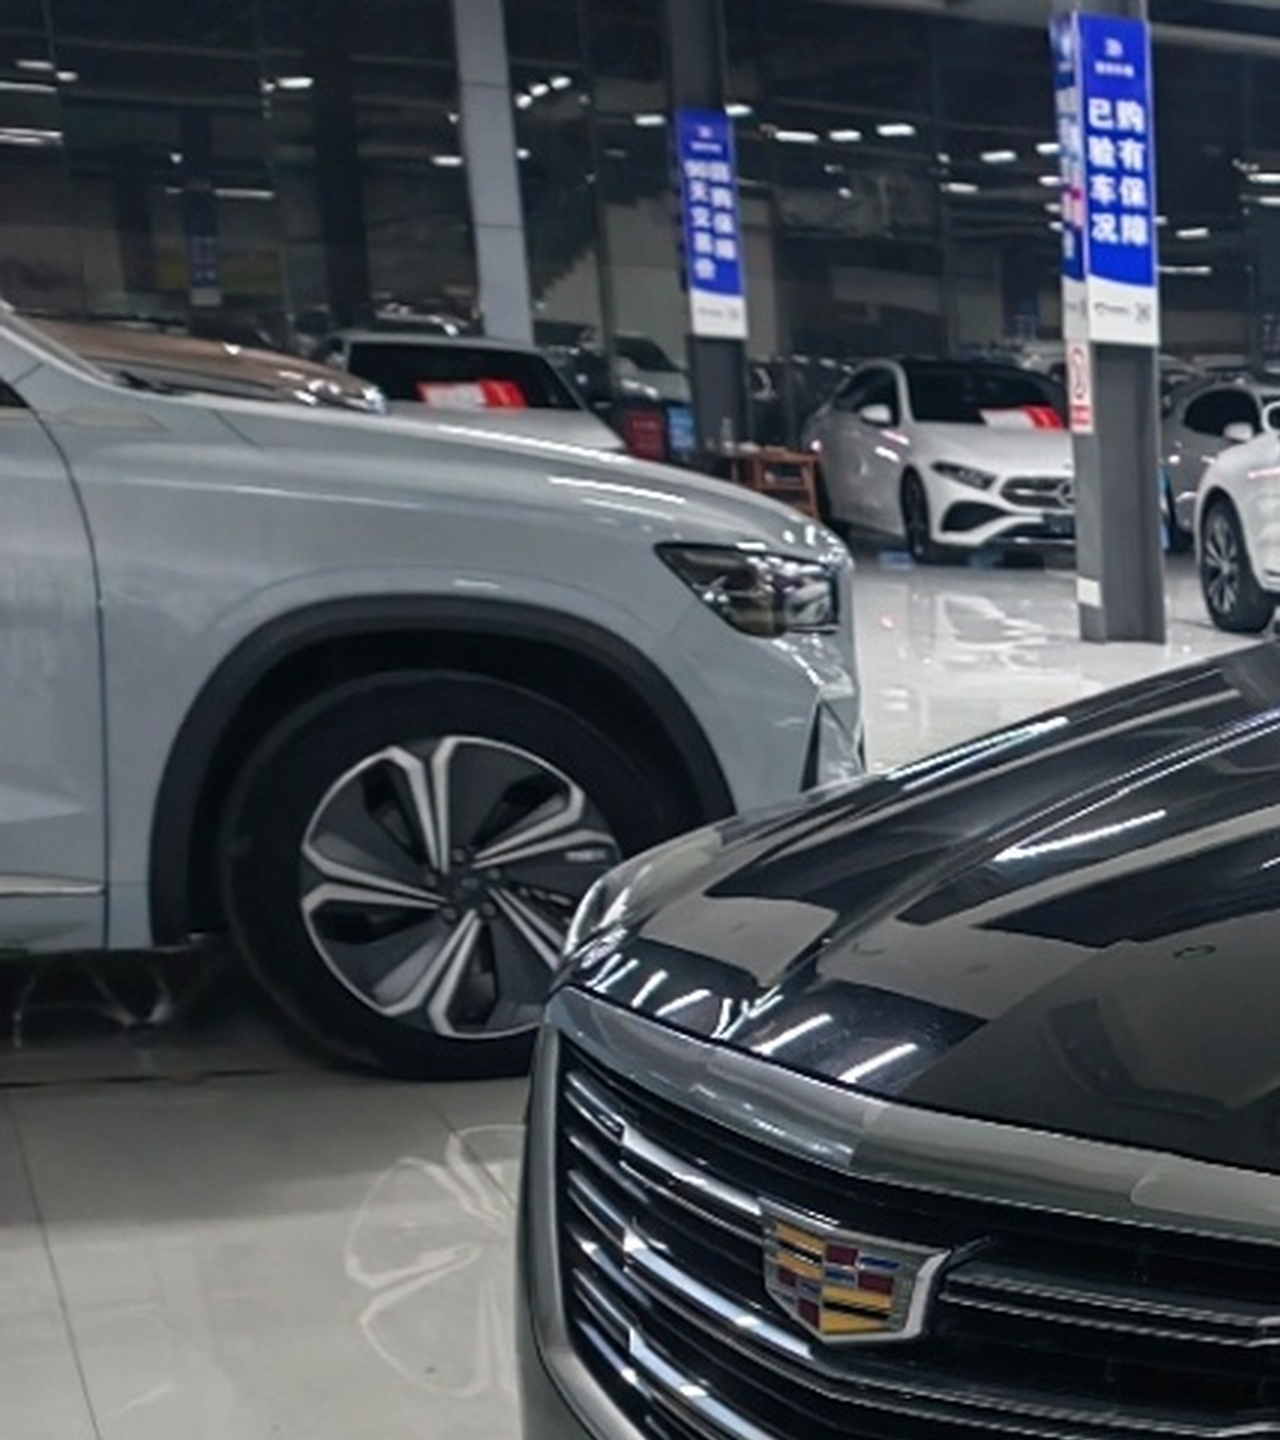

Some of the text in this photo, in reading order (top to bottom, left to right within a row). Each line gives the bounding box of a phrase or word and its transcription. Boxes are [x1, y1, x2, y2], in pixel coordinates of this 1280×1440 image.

[1088, 97, 1118, 245] 已验车况
[1116, 99, 1149, 247] 购有保障
